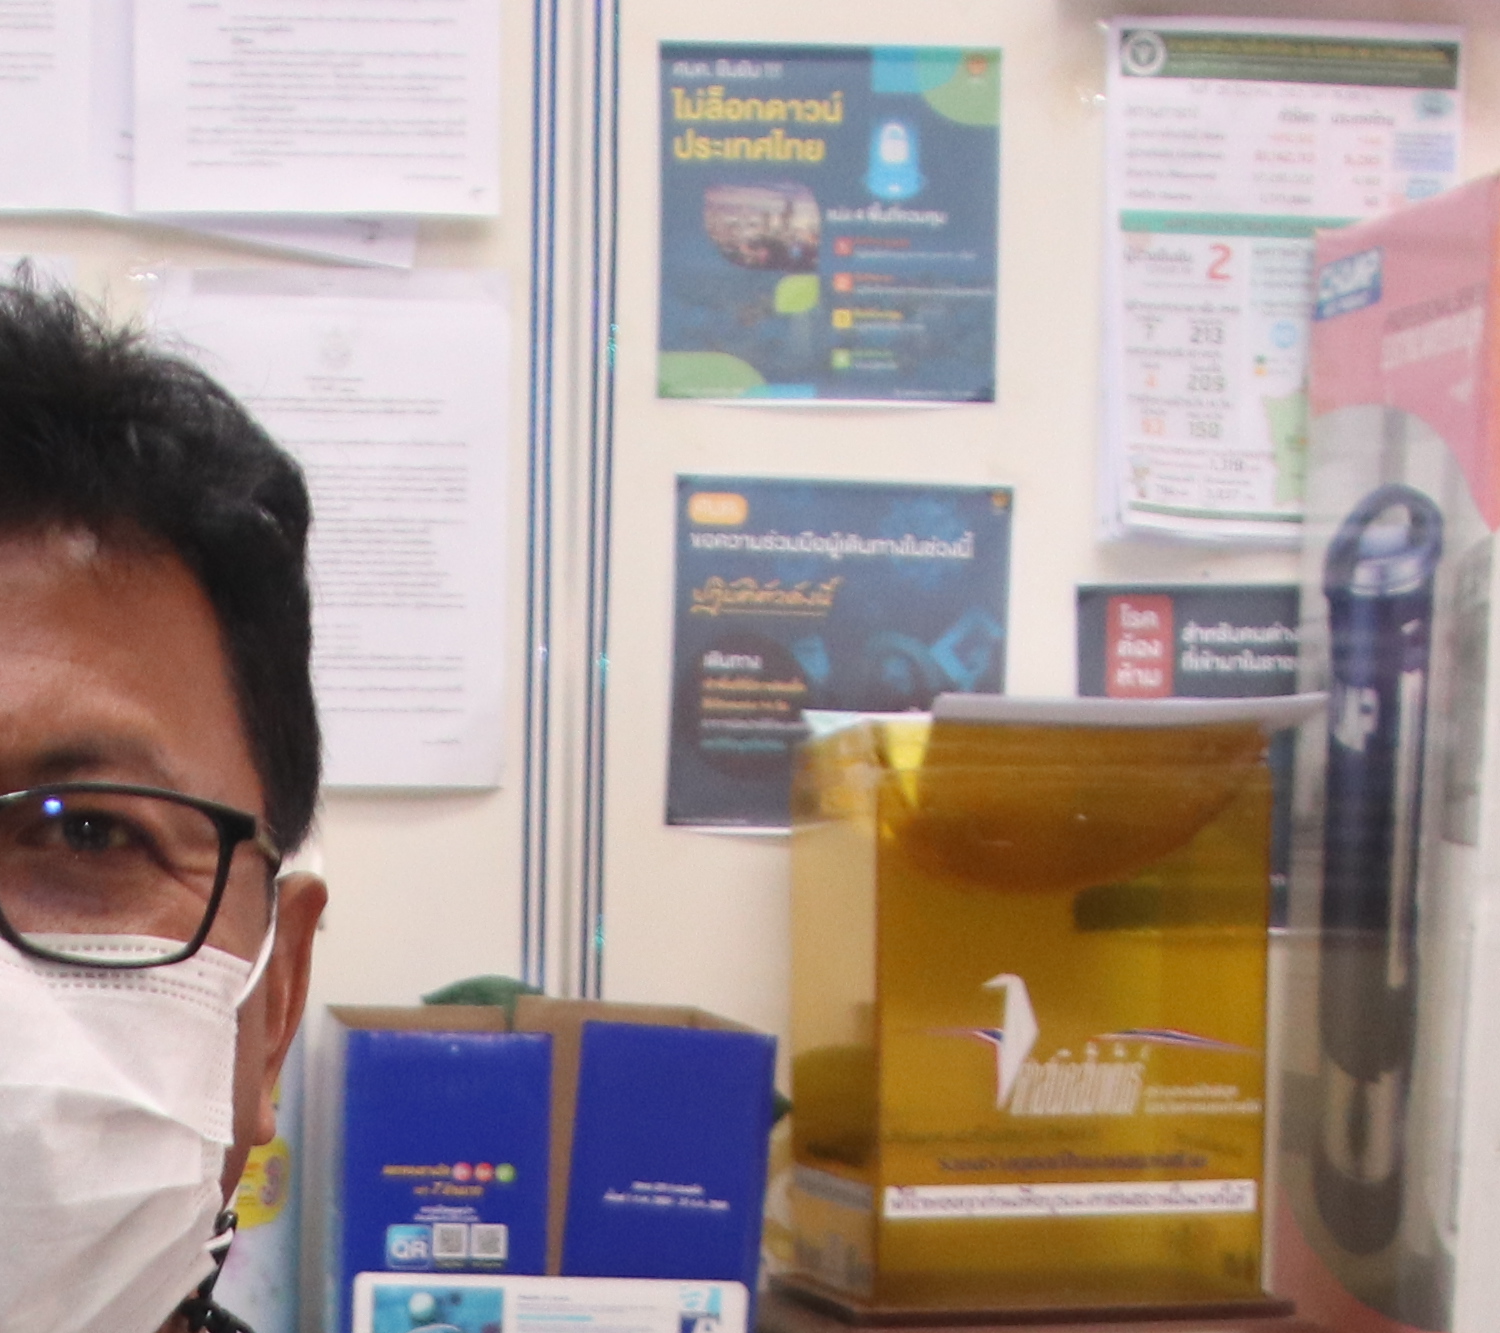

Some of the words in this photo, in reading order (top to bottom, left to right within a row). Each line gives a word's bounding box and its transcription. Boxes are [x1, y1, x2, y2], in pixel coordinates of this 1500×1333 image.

[671, 84, 845, 124] ไม่ล็อกดาวน์
[673, 127, 827, 163] ประเทศไทย
[1206, 243, 1232, 282] 2
[1118, 602, 1161, 631] โรค
[1116, 631, 1165, 659] ต้อง
[1115, 661, 1164, 689] ห้าม
[390, 1238, 430, 1260] QR
